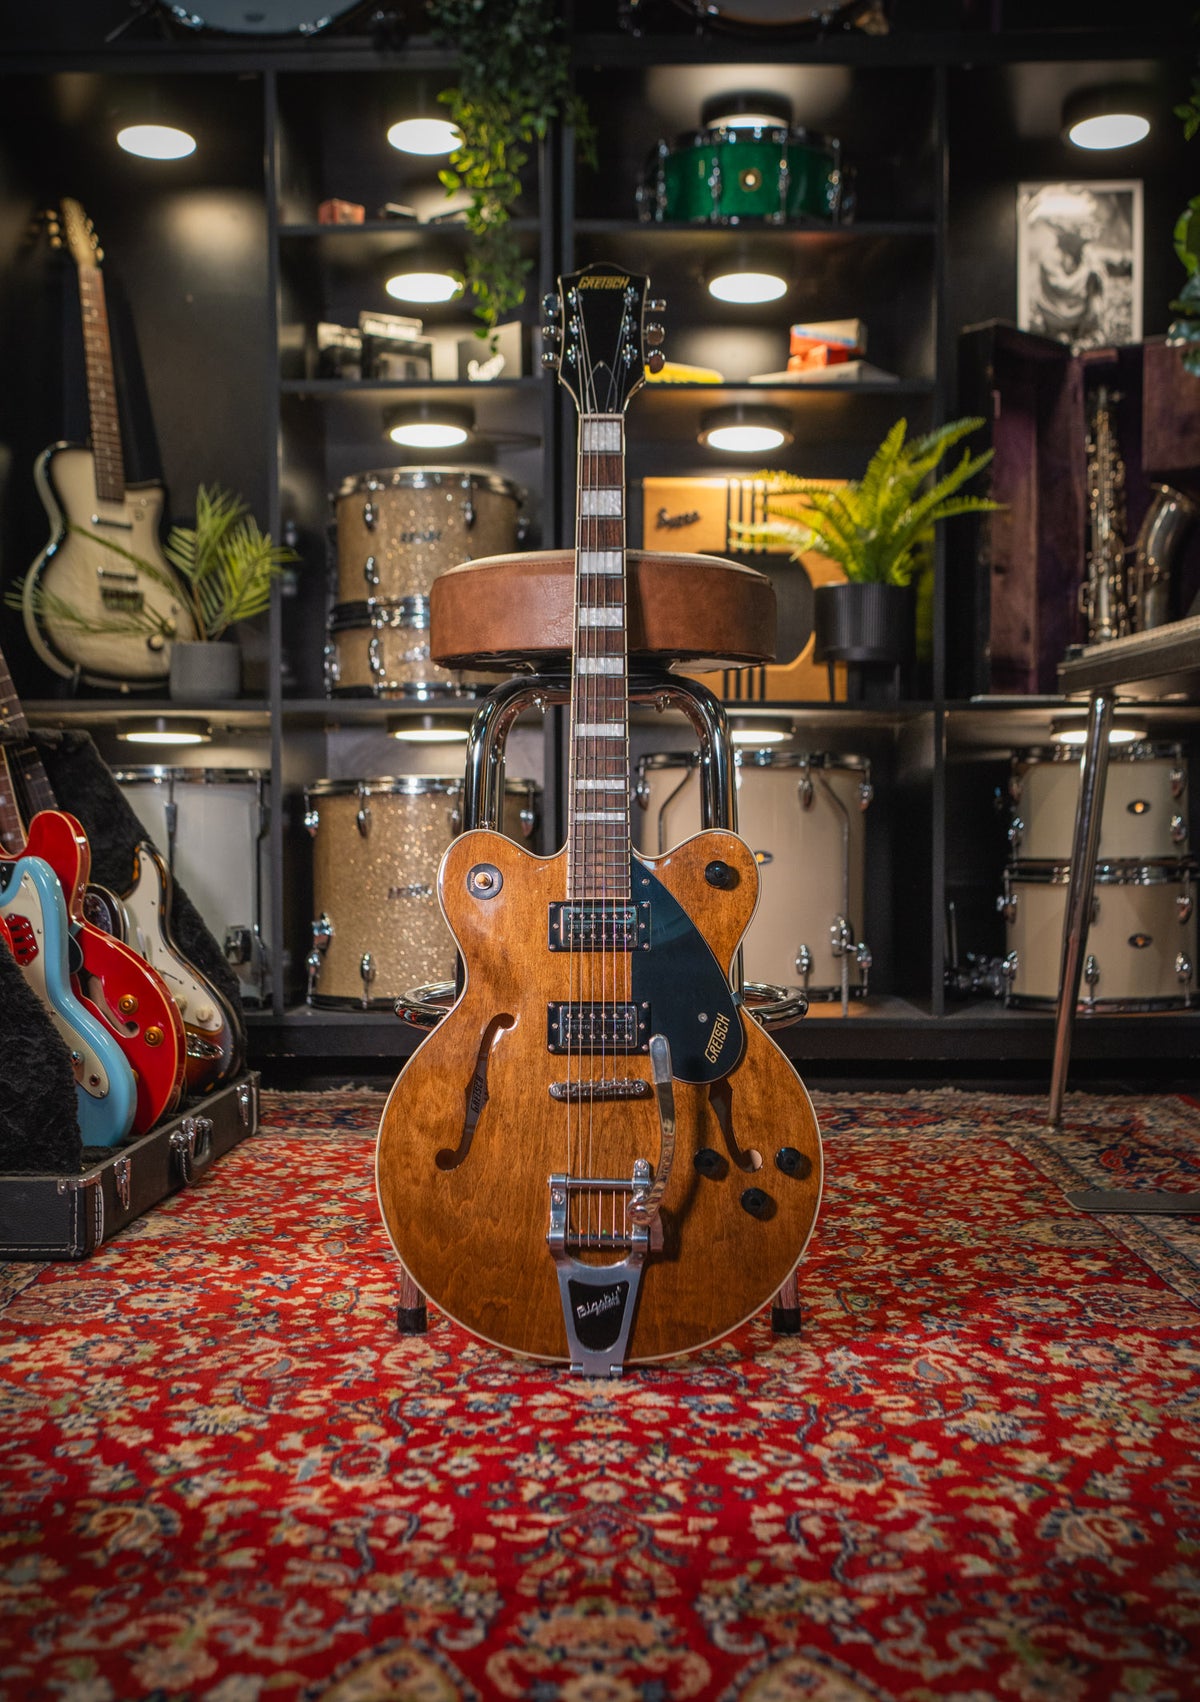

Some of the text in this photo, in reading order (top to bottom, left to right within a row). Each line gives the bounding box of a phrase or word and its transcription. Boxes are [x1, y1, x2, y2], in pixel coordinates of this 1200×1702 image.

[578, 276, 630, 289] GRETSCH
[704, 1012, 730, 1064] GRETSCH
[576, 1285, 622, 1319] Bigsby
